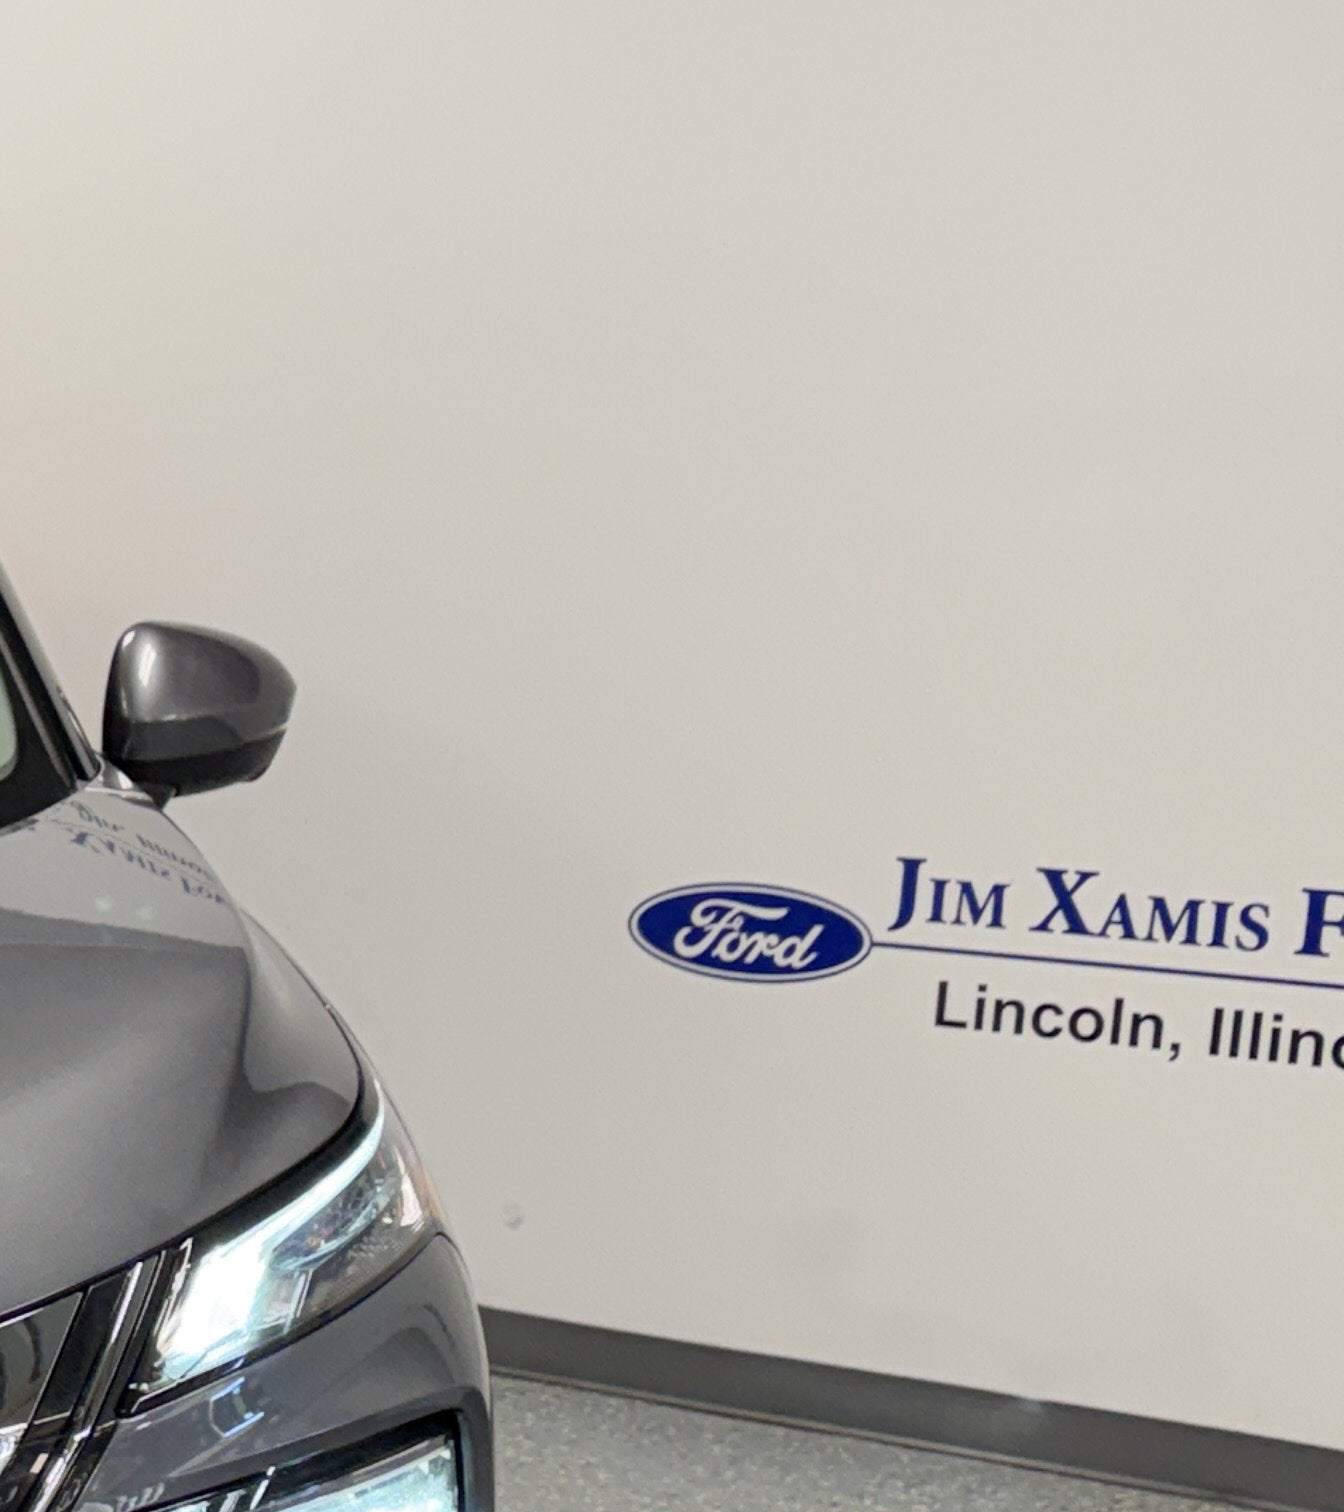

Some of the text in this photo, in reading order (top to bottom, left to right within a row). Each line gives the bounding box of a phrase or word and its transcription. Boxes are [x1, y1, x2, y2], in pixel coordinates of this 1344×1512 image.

[673, 898, 825, 969] Ford
[887, 857, 1012, 932] JIM
[1028, 867, 1270, 952] XAMIS
[934, 980, 1181, 1061] Lincoln,
